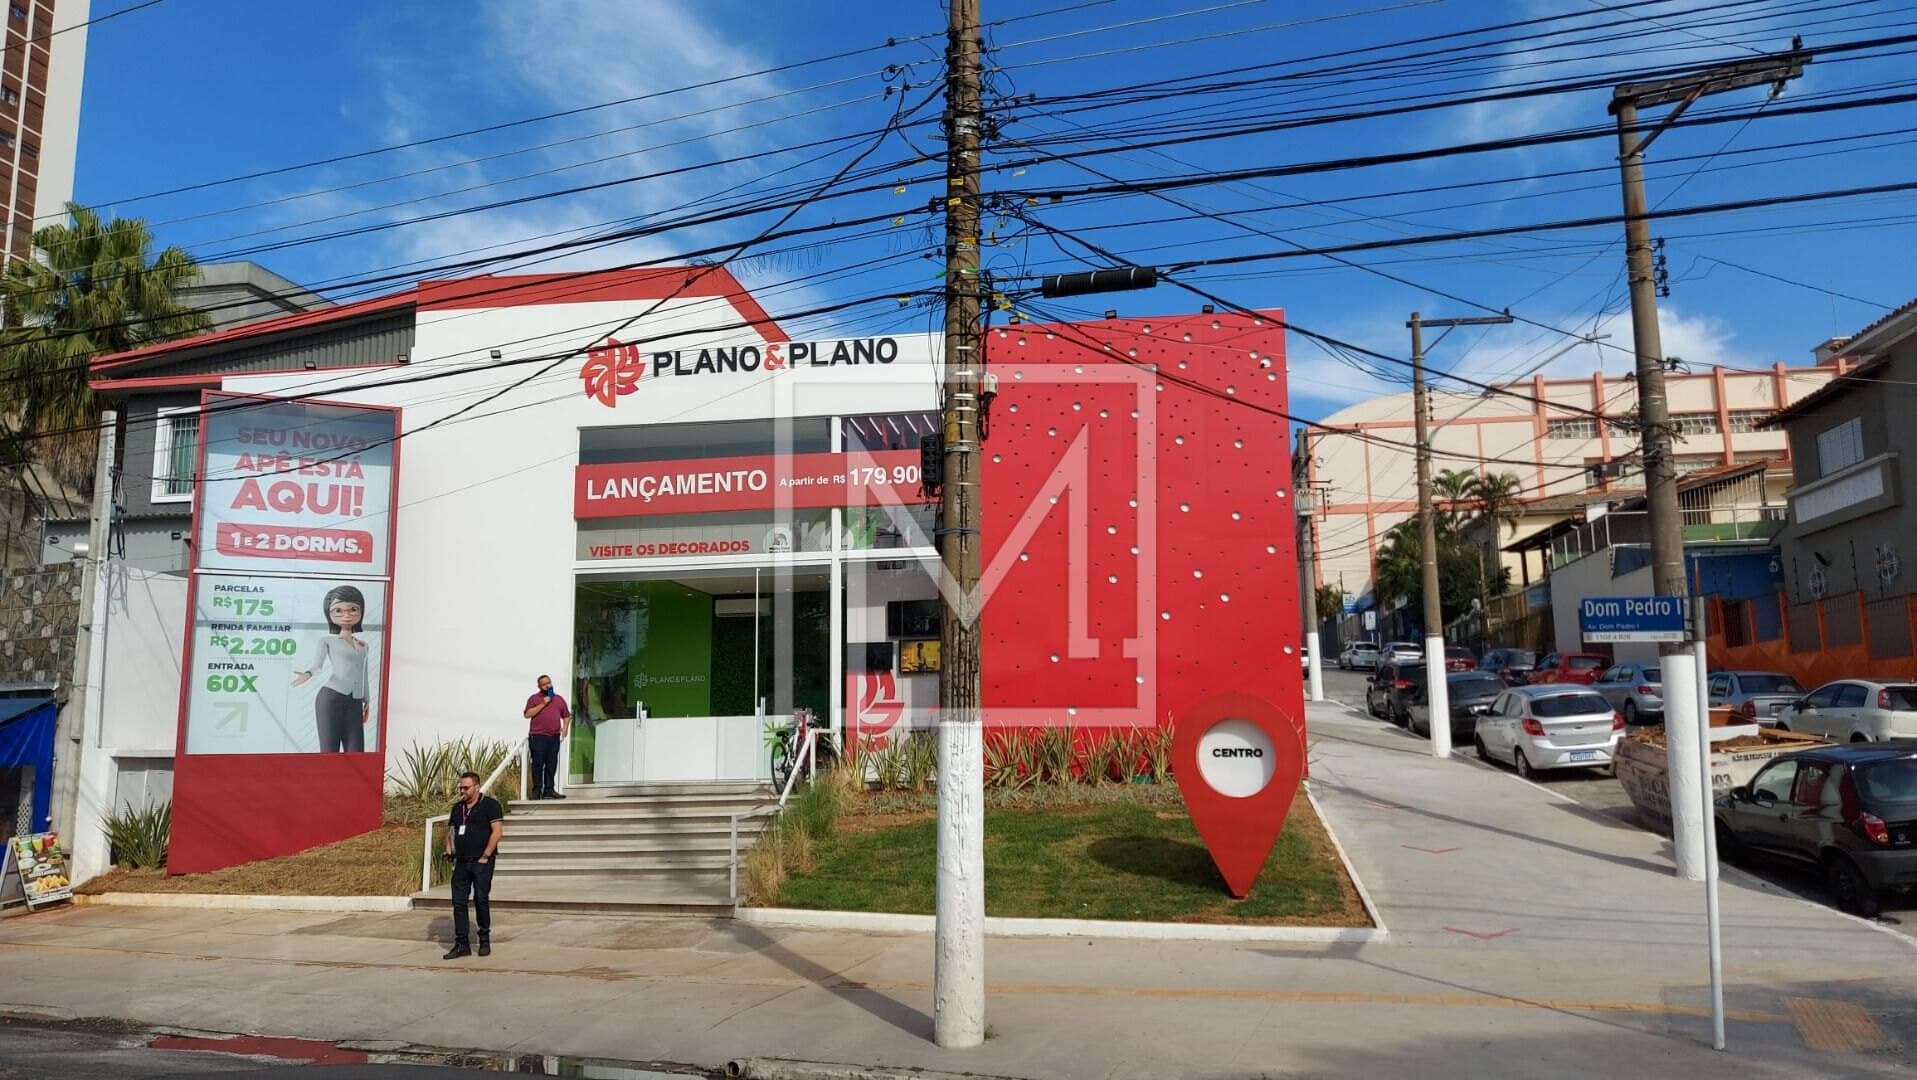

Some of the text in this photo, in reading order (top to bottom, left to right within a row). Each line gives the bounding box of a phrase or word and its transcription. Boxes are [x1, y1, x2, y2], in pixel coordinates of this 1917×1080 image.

[237, 426, 367, 452] SEU NOVO
[234, 449, 365, 480] APÊ ESTÁ
[586, 464, 922, 502] LANÇAMENTO A partir de R$ 179.90
[230, 478, 365, 517] AQUI!
[231, 532, 240, 548] 1
[256, 532, 270, 550] 2
[274, 534, 363, 554] DORMS.
[590, 540, 750, 557] VISITE OS DECORADOS
[214, 584, 265, 593] PARCELAS
[1584, 598, 1681, 617] Dom Pedro I
[211, 623, 292, 633] RENDA FAMILIAR
[208, 662, 254, 671] ENTRADA
[206, 675, 259, 693] 60X
[1212, 748, 1264, 758] CENTRO
